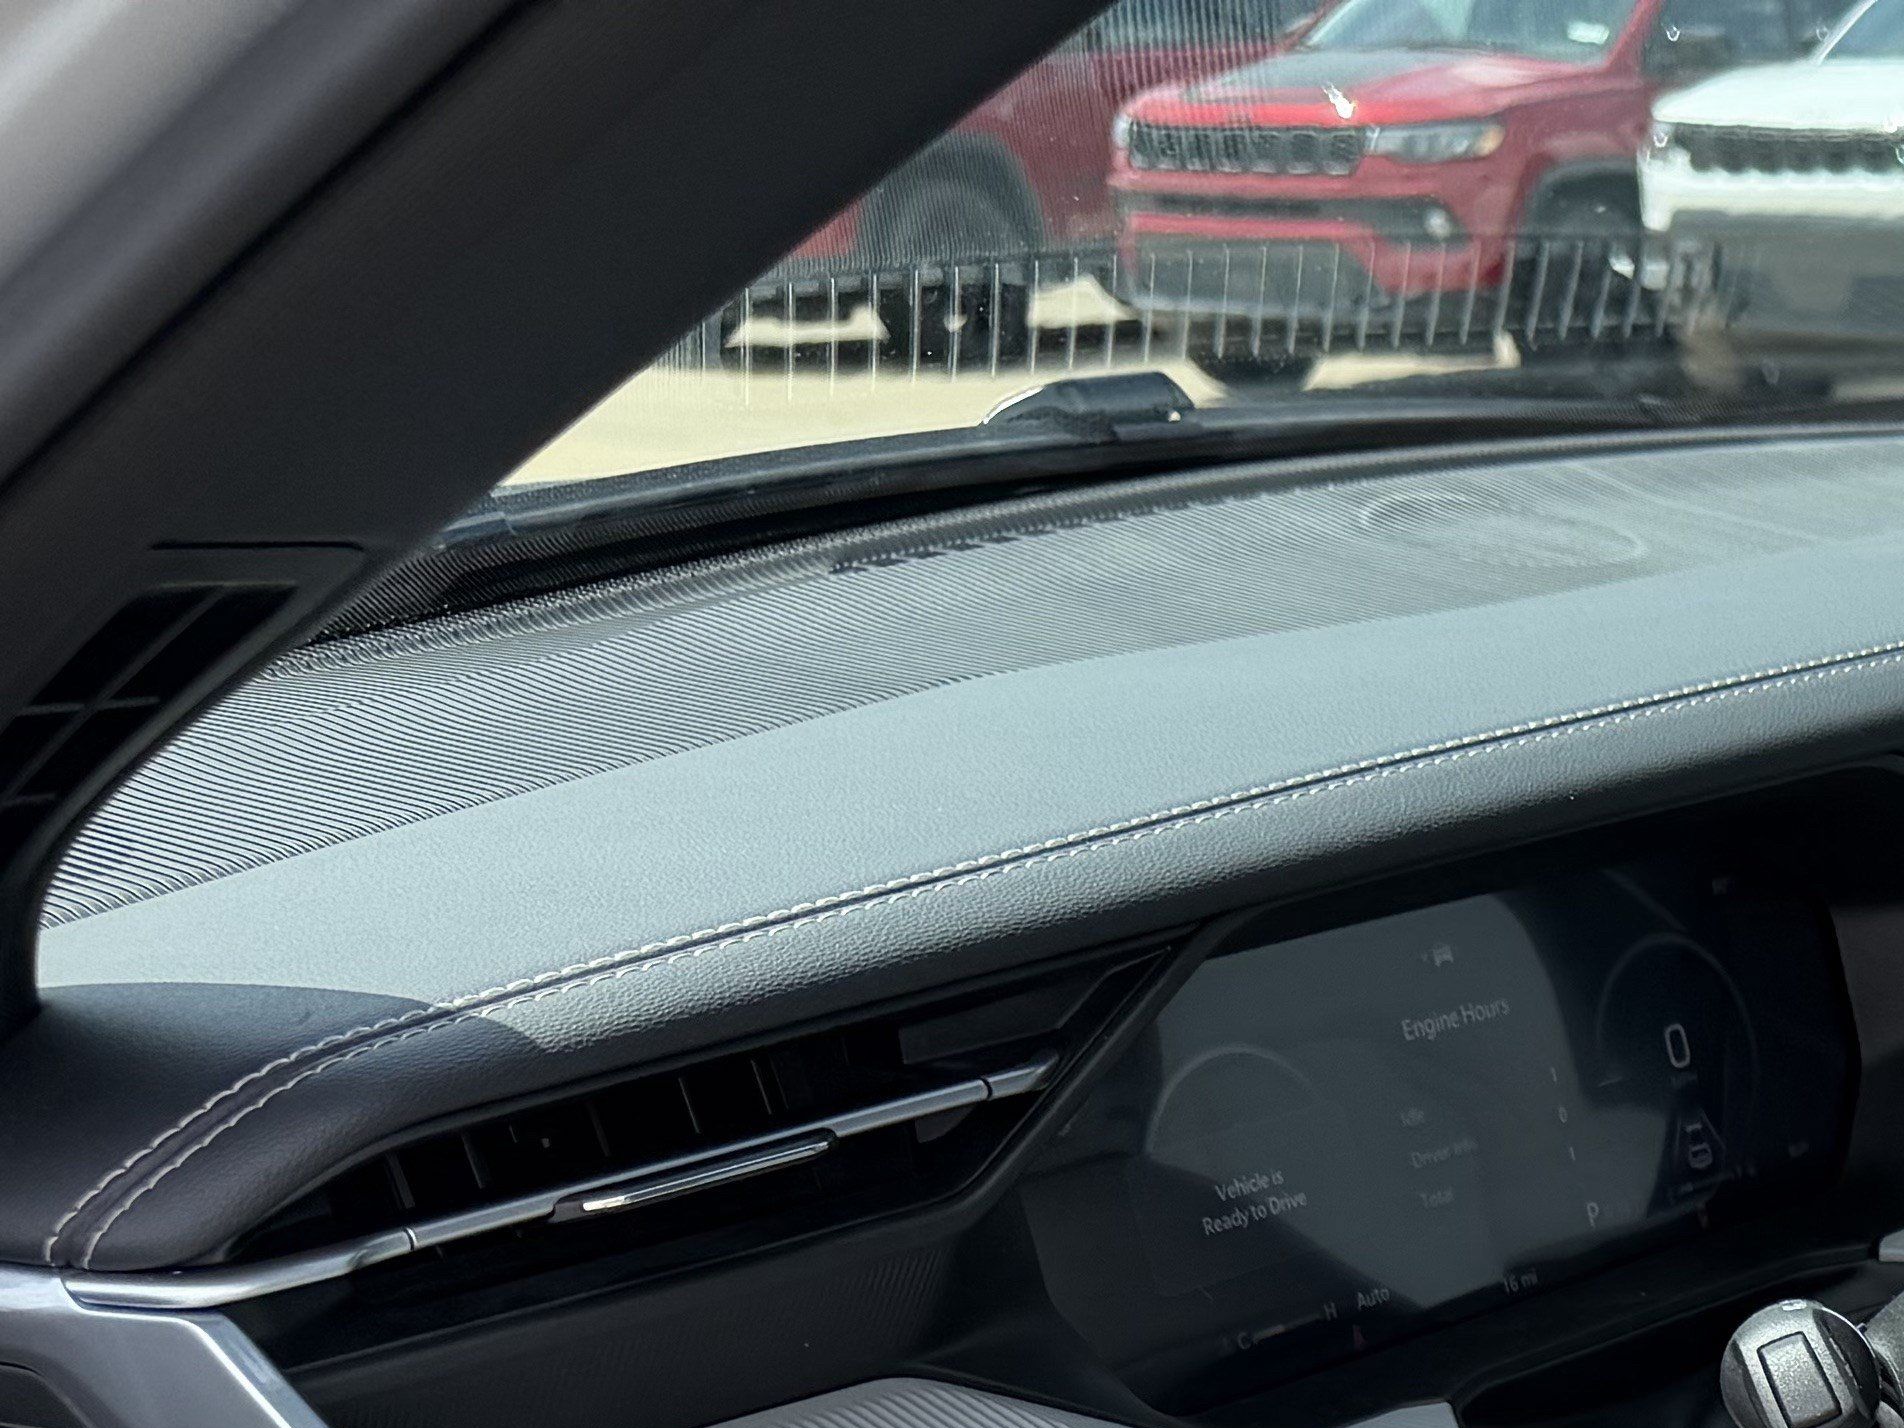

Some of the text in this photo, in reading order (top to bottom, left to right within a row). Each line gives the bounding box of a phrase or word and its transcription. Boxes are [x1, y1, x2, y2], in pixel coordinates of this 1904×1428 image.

[1401, 998, 1510, 1041] Engine Hours
[1664, 1023, 1692, 1069] 0
[1214, 1169, 1285, 1202] Vehicle is
[1201, 1191, 1308, 1237] Ready to Drive
[1323, 1302, 1338, 1321] H
[1355, 1286, 1391, 1312] Auto
